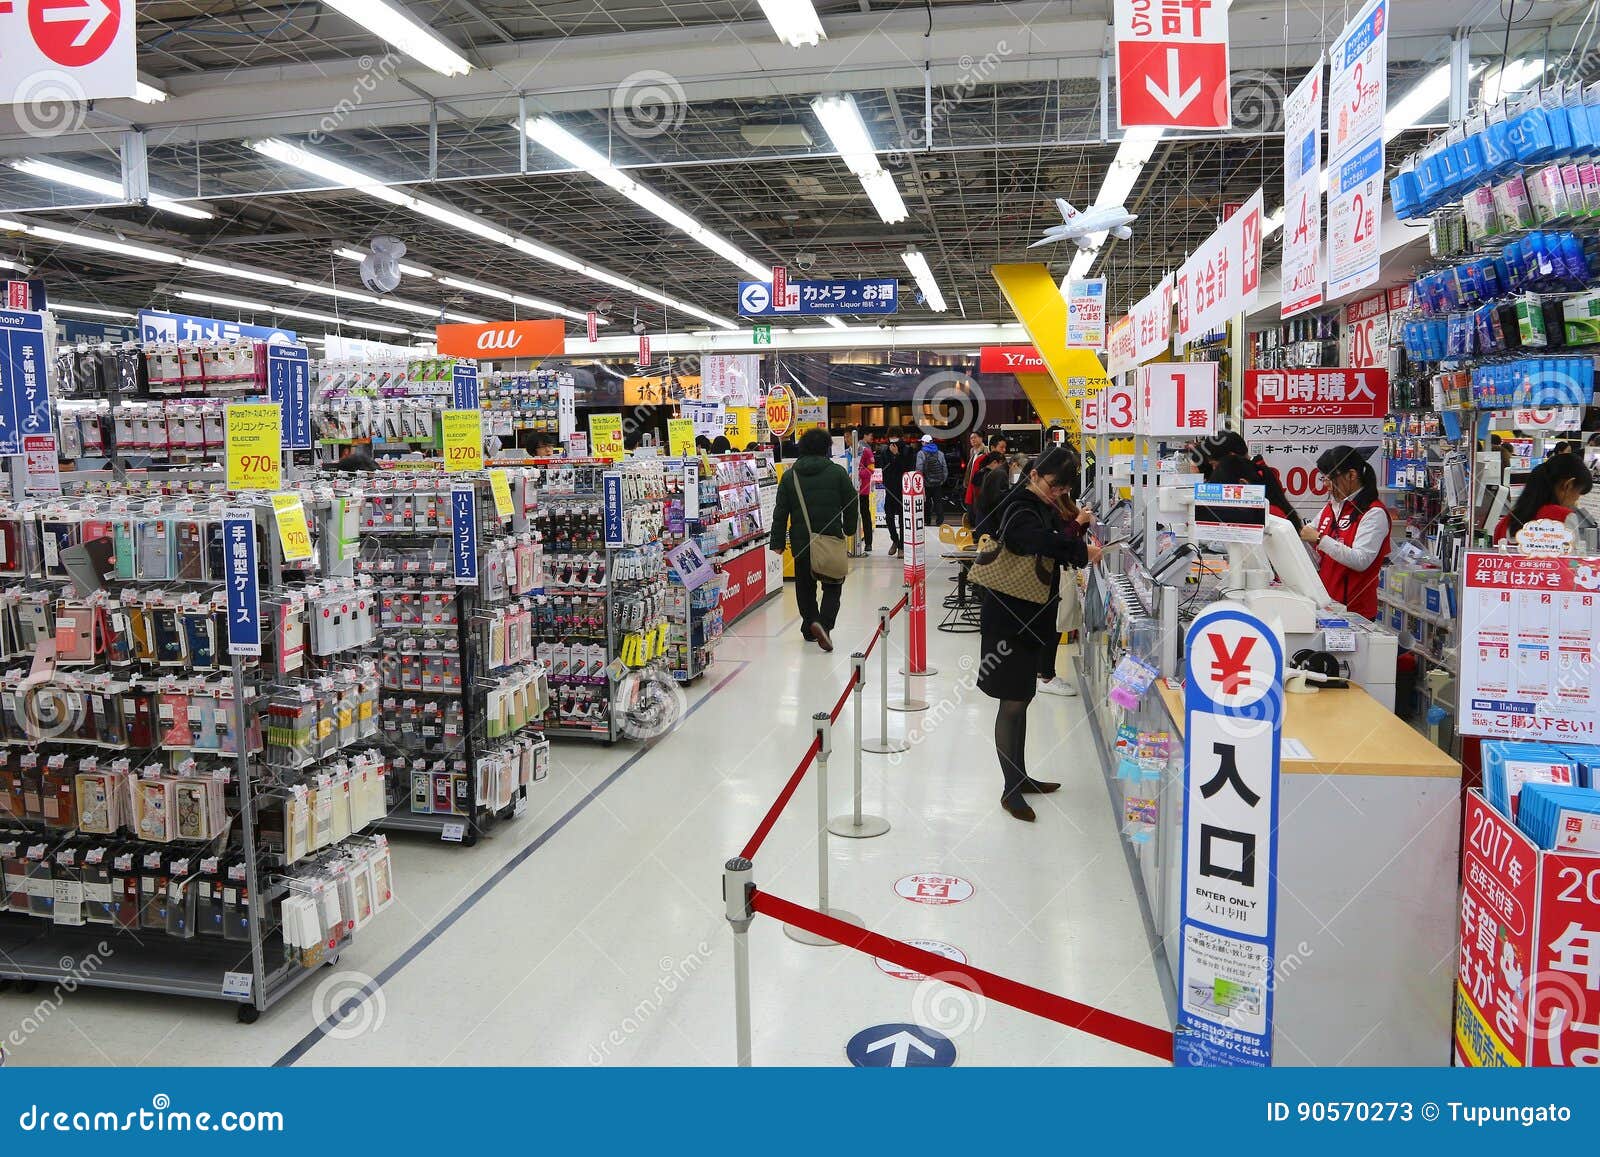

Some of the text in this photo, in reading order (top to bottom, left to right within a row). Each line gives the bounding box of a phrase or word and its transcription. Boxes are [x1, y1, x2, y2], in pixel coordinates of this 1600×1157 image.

[1195, 246, 1229, 315] お会計
[803, 284, 894, 300] カメラ・お酒
[477, 328, 522, 350] au
[1002, 352, 1045, 366] Y!mo
[890, 367, 920, 375] ZARA
[23, 345, 40, 428] 手帳型ケース
[1257, 373, 1377, 402] 同時購入
[1289, 405, 1342, 414] キャンペーン
[230, 421, 278, 432] シリコンケース
[1252, 424, 1379, 435] スマートフォンと同時購入で
[1265, 445, 1319, 454] キーボードが
[240, 455, 272, 473] 970
[457, 493, 472, 576] ハード・ソフトケース
[1477, 558, 1512, 569] 2017年
[231, 525, 251, 624] 手帳型ケース
[1475, 569, 1561, 587] 年賀はがき
[1495, 714, 1593, 734] ご購入下さい!
[1199, 742, 1261, 888] 入口
[1469, 807, 1523, 889] 2017年
[911, 875, 960, 885] お会計
[1196, 887, 1257, 909] ENTER ONLY
[1469, 860, 1514, 921] お年玉付き
[1197, 931, 1253, 952] ポイントカードの
